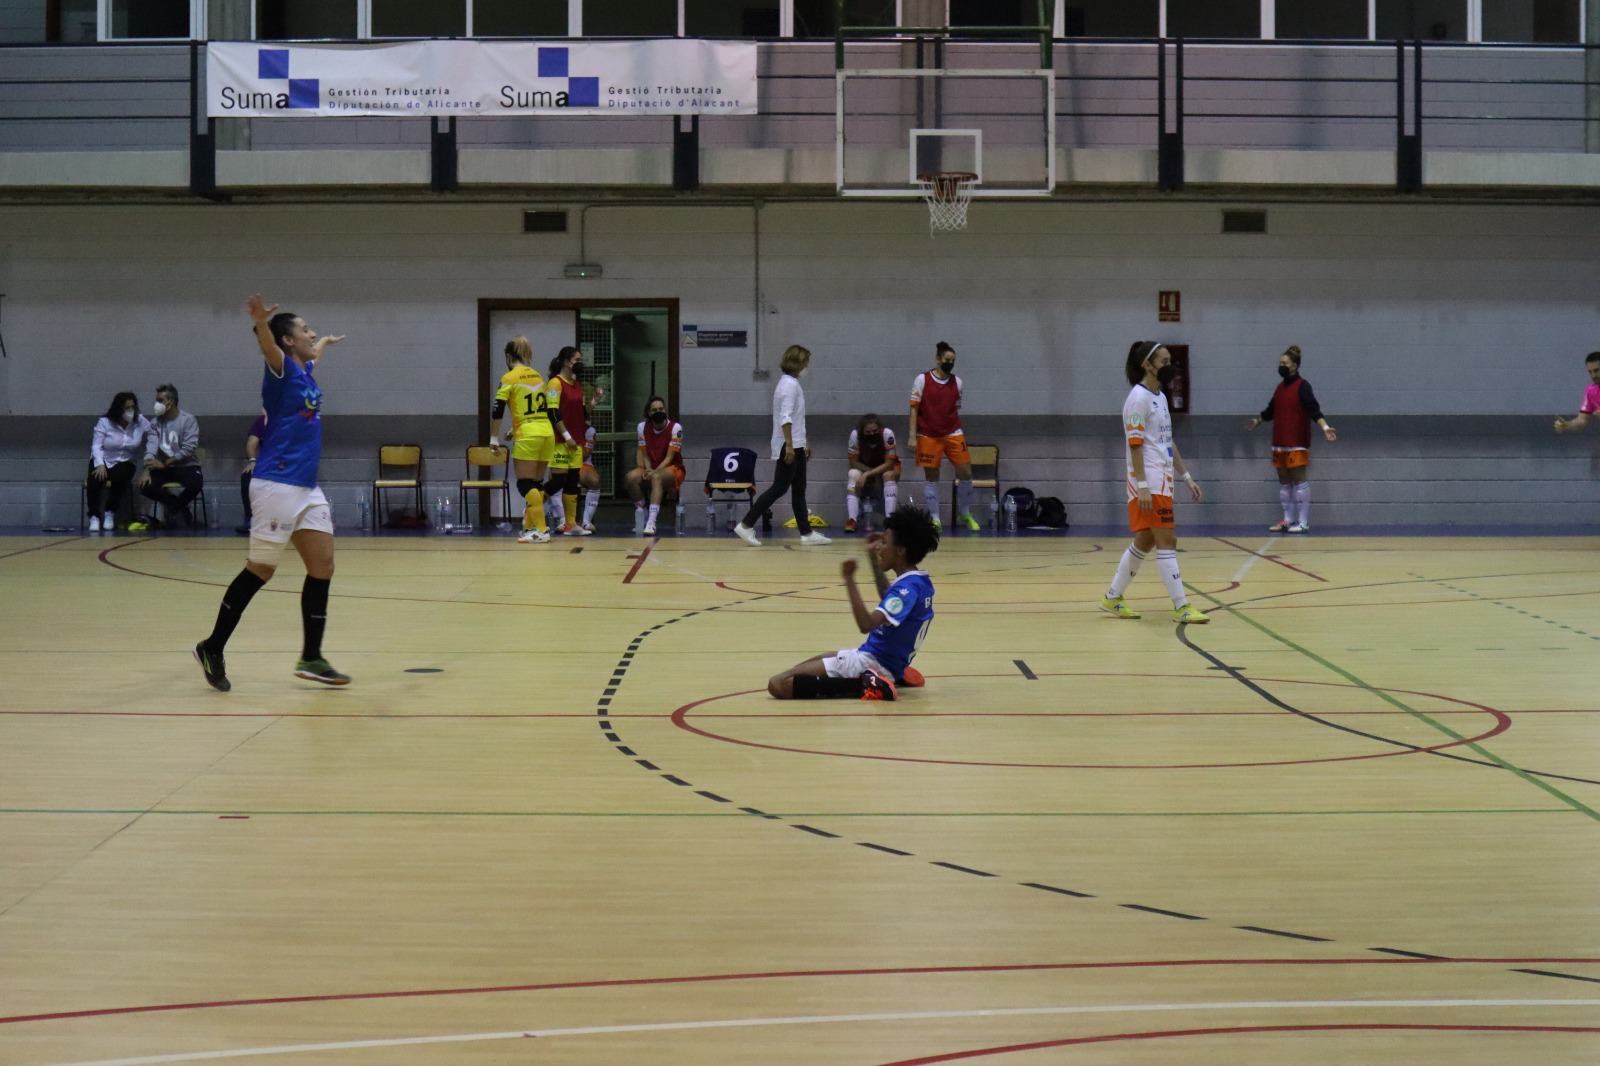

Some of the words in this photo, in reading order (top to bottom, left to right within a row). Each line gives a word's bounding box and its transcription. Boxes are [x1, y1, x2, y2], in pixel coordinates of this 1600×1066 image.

[220, 86, 290, 109] Suma
[328, 88, 378, 97] Gestión
[385, 86, 450, 96] Tributaria
[500, 85, 569, 108] Suma
[608, 86, 650, 95] Gestió
[328, 100, 399, 110] Diputación
[406, 100, 421, 109] de
[427, 100, 481, 109] Alicante
[608, 99, 671, 109] Diputació
[678, 98, 740, 108] d'Alacant
[523, 391, 547, 416] 12
[723, 451, 740, 473] 6
